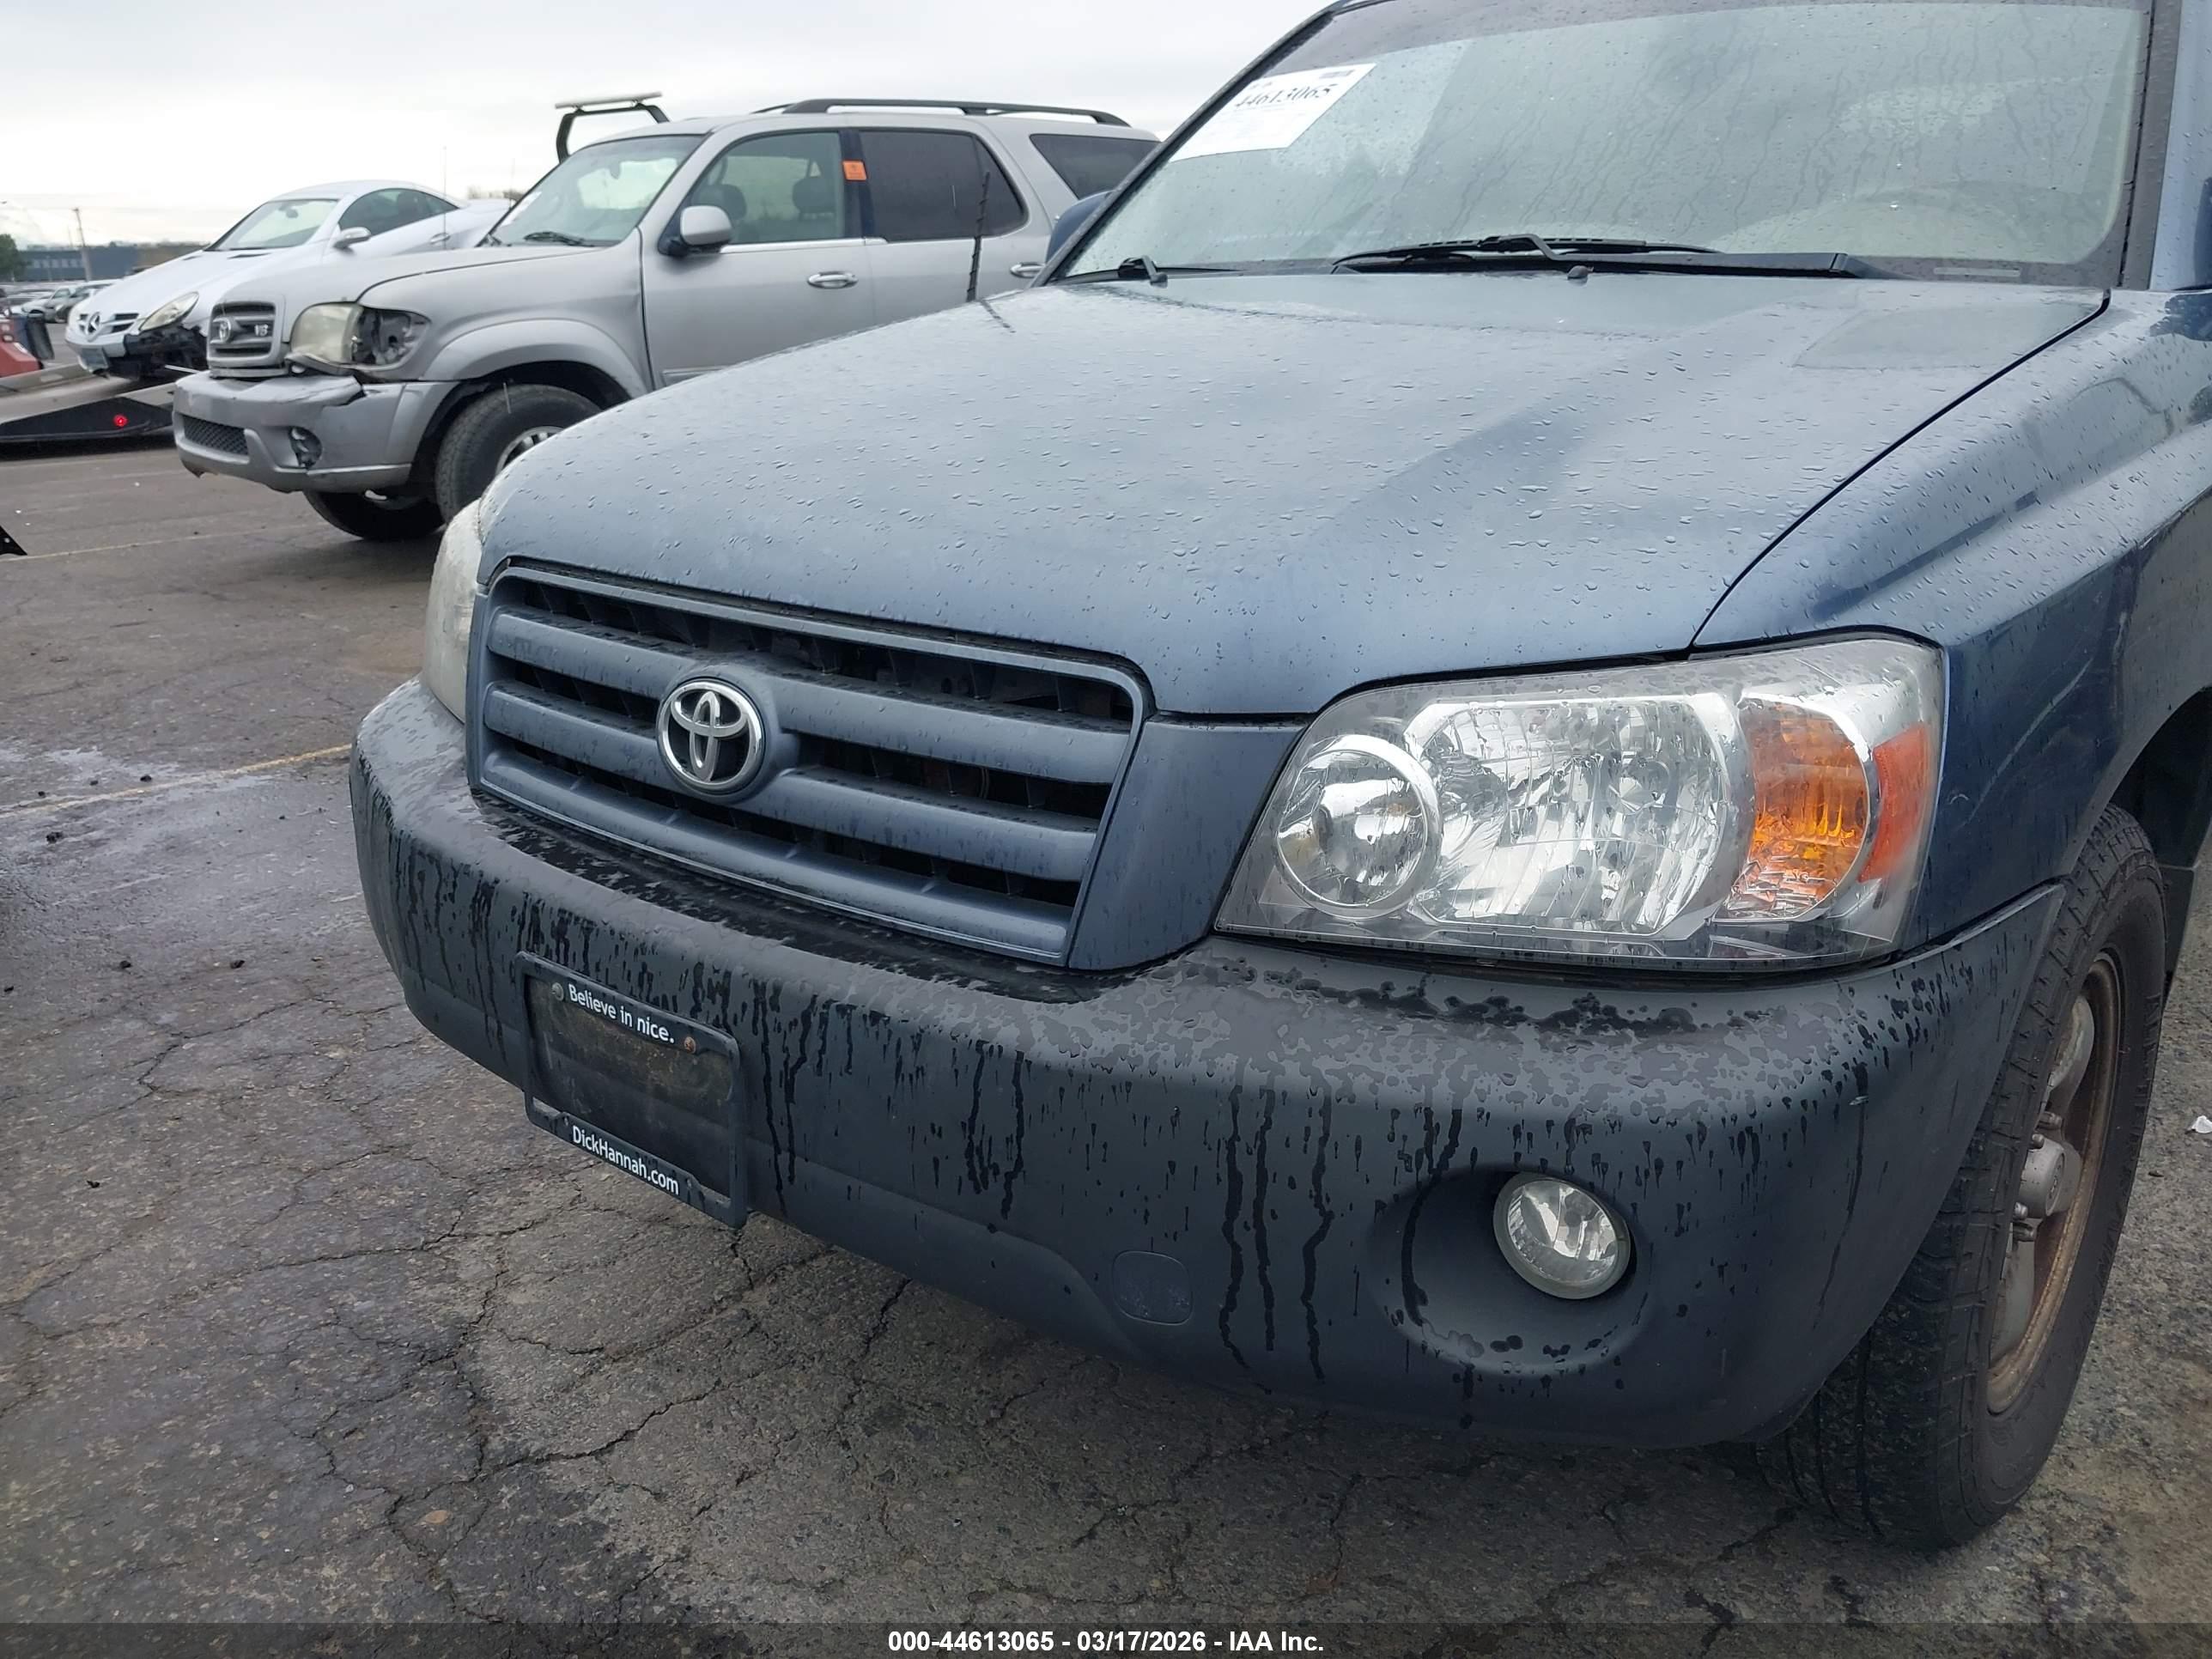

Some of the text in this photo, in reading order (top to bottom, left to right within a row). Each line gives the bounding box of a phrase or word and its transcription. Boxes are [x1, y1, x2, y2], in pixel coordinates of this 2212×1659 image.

[568, 984, 675, 1044] Believe in nice.
[573, 1125, 679, 1195] DickHannah.com
